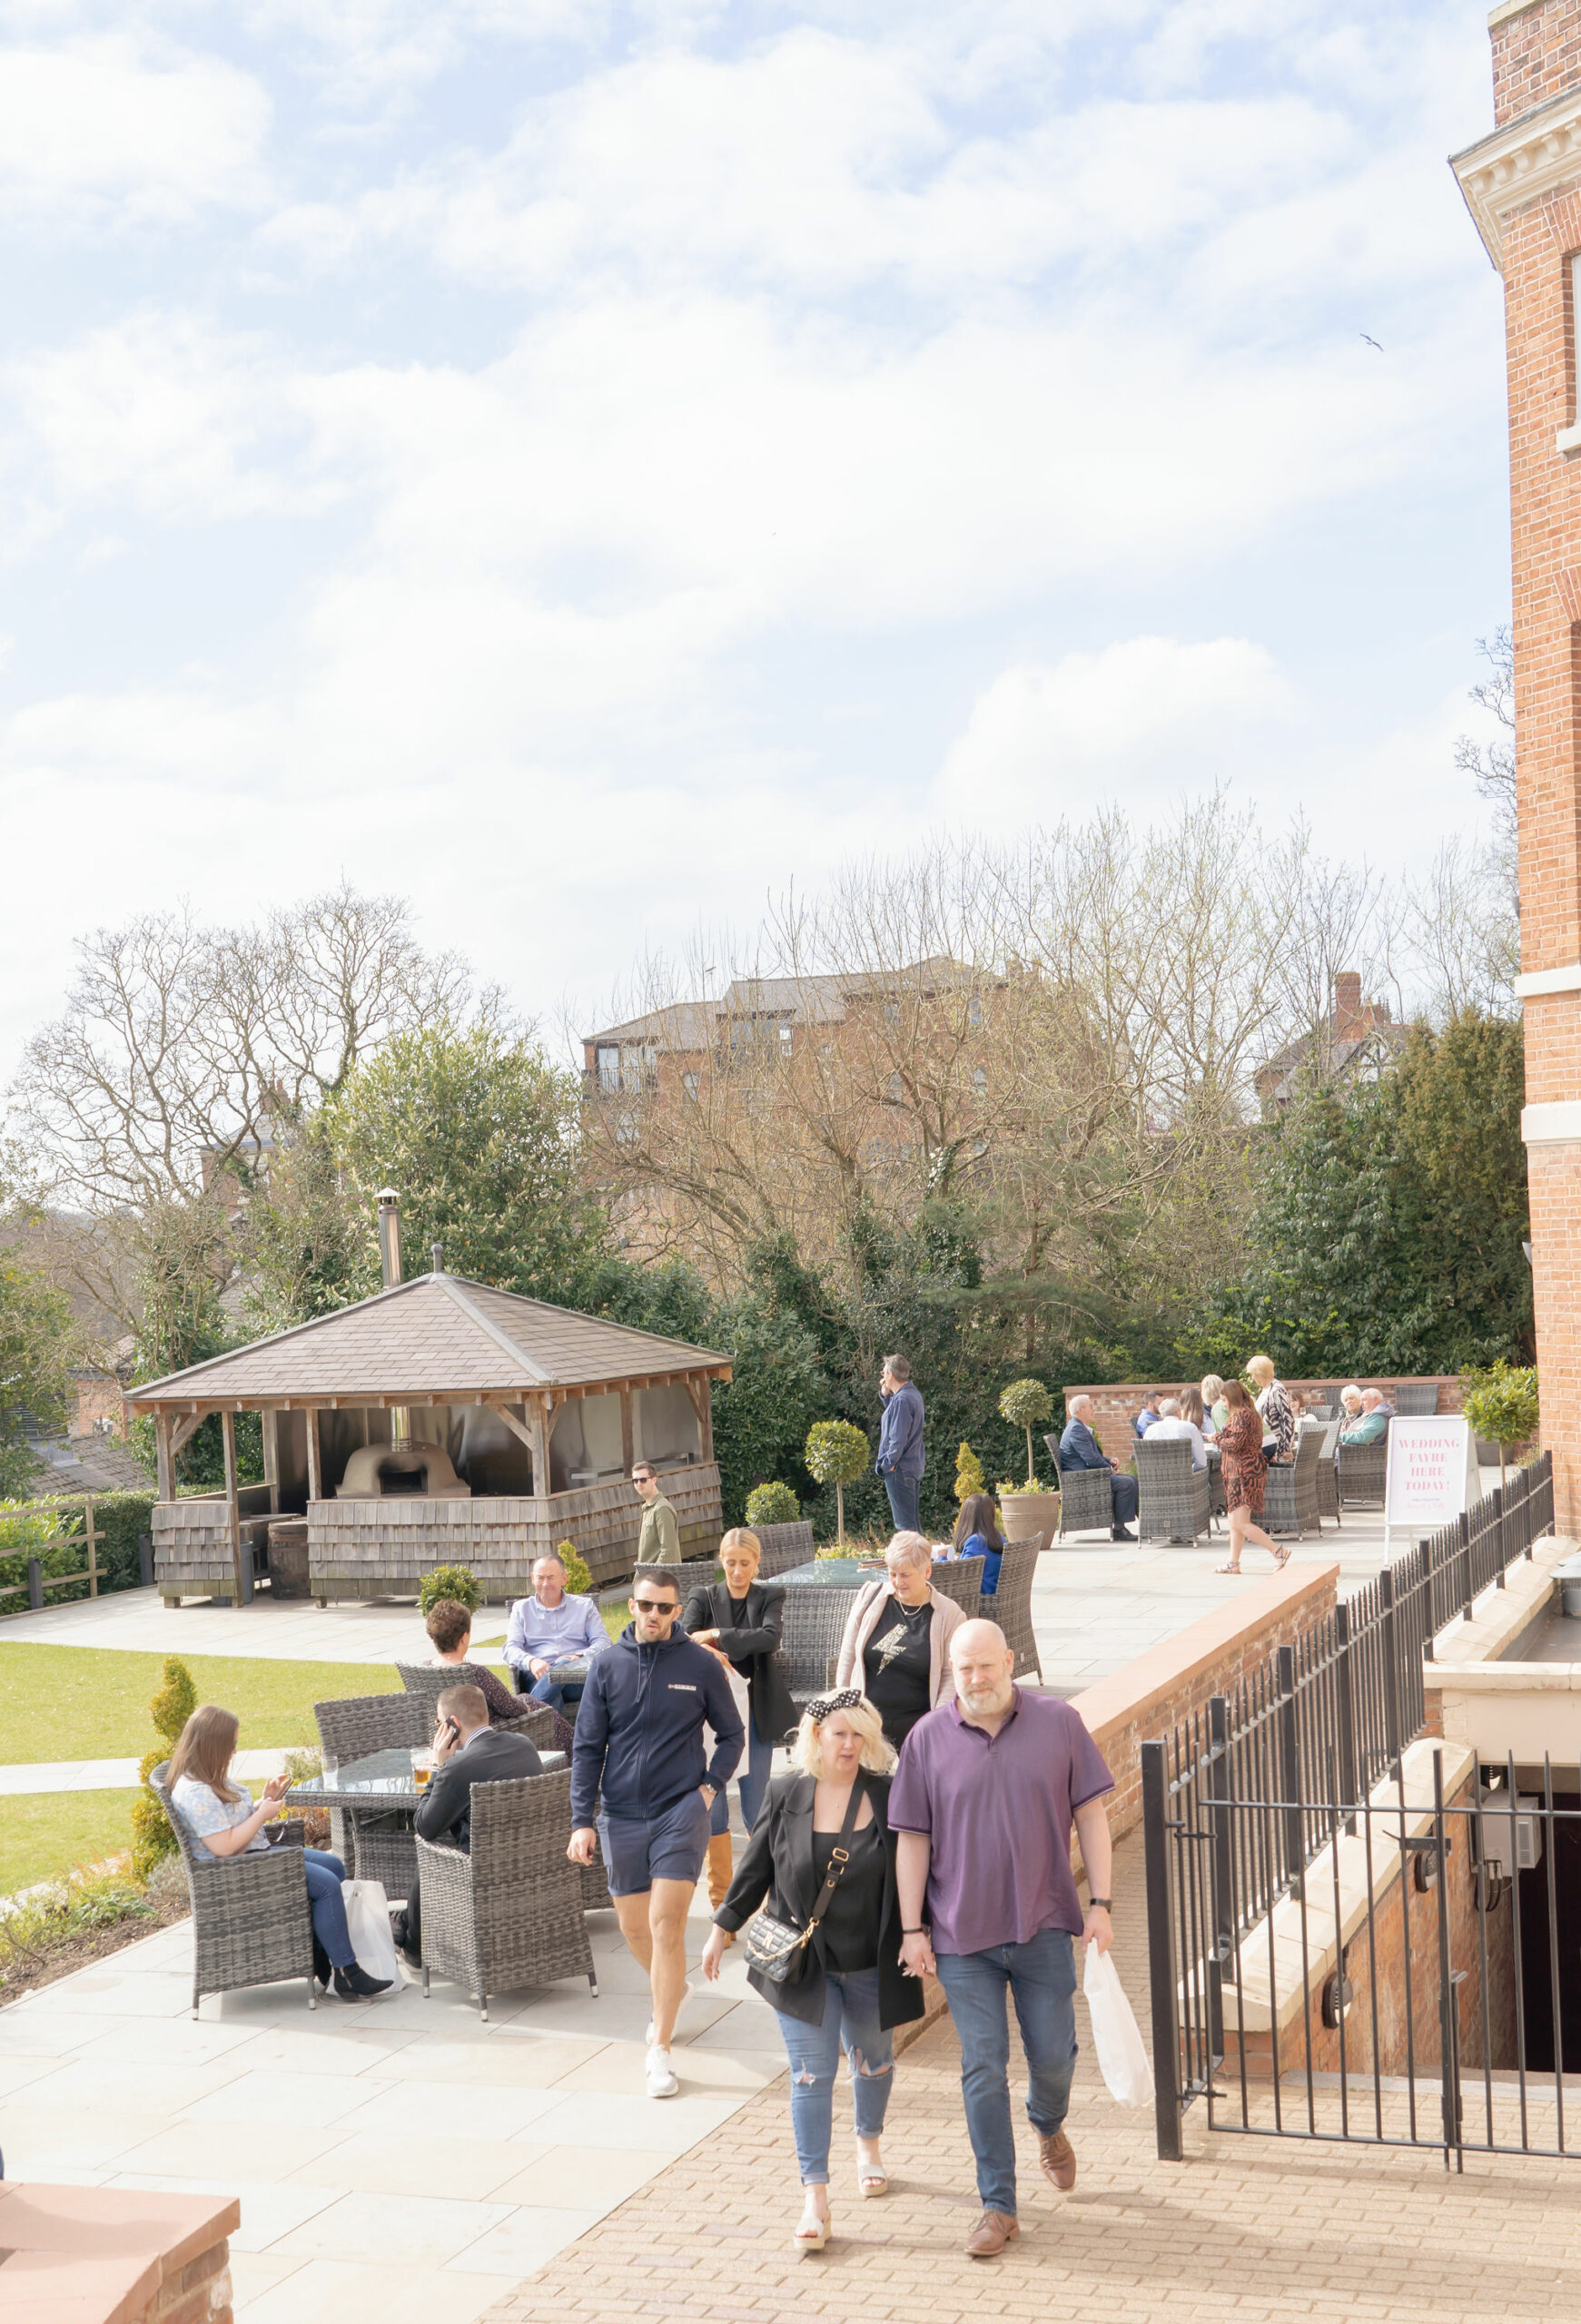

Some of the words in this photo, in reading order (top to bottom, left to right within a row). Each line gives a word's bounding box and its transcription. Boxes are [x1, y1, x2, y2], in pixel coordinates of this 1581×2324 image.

[1398, 1439, 1459, 1448] WEDDING
[1409, 1452, 1448, 1462] FAYRE
[1411, 1467, 1445, 1476] HERE
[1404, 1481, 1450, 1491] TODAY!
